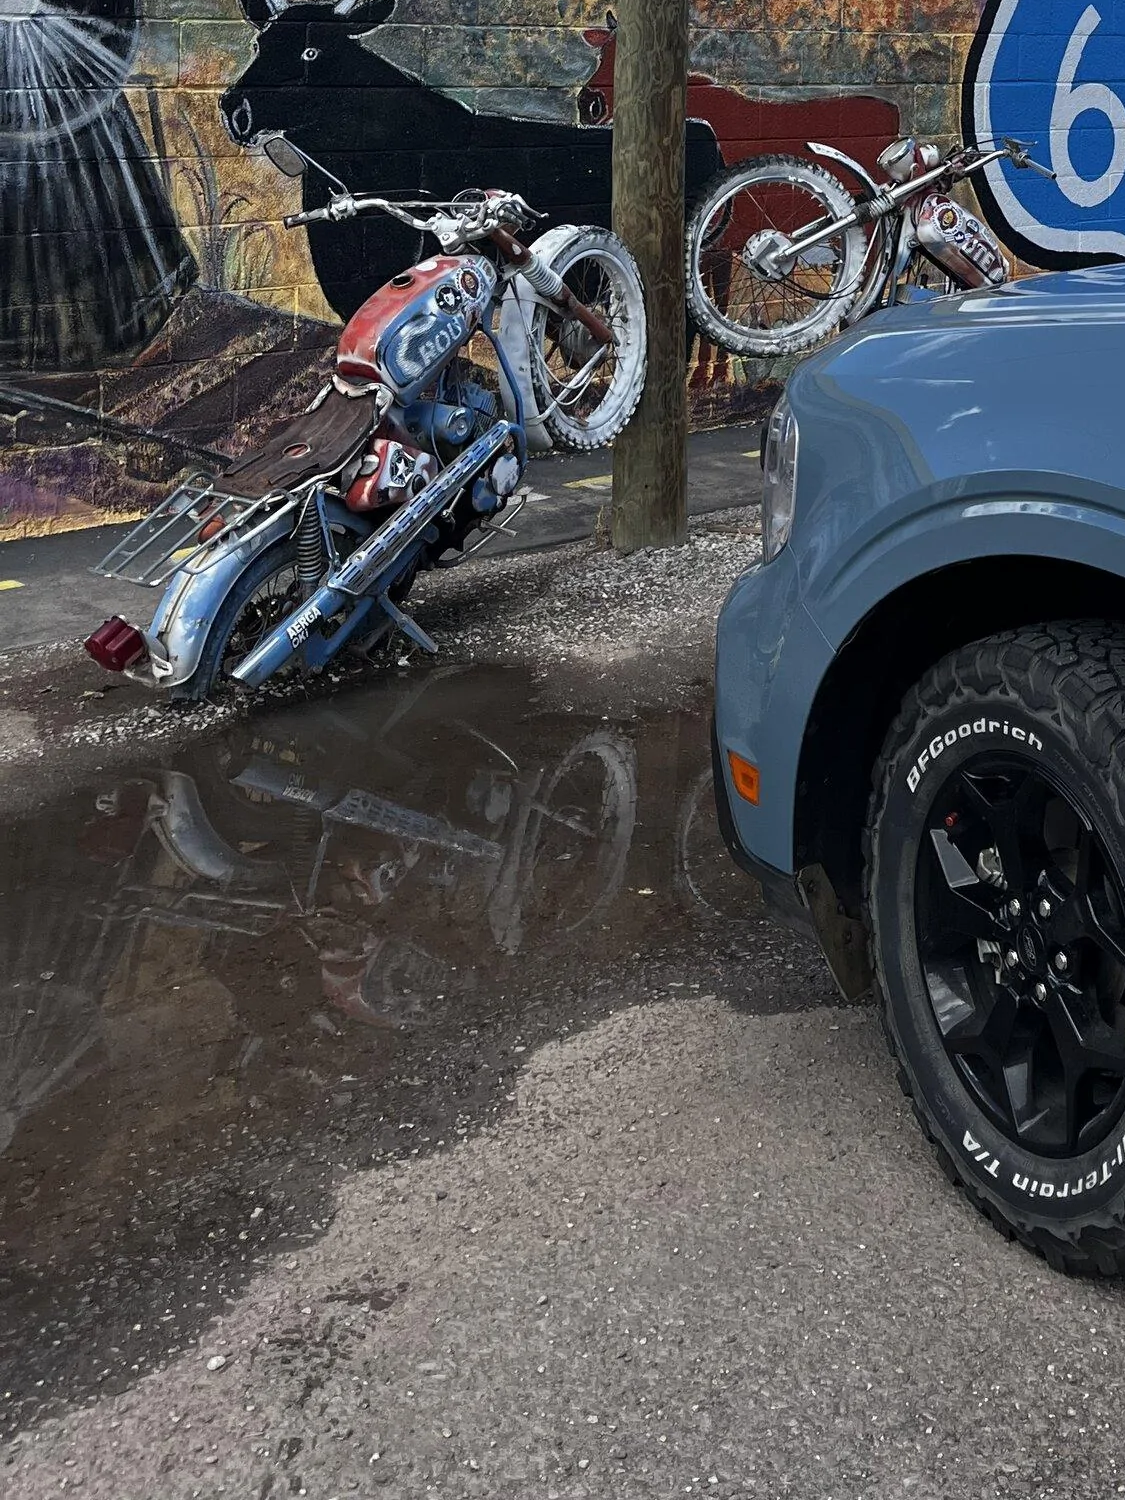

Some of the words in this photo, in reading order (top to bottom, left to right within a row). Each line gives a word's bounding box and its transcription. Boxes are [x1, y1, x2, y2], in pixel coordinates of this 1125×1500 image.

[285, 605, 322, 641] AERGA
[905, 717, 1044, 793] BFGoodrich
[962, 1129, 1001, 1179] T/A
